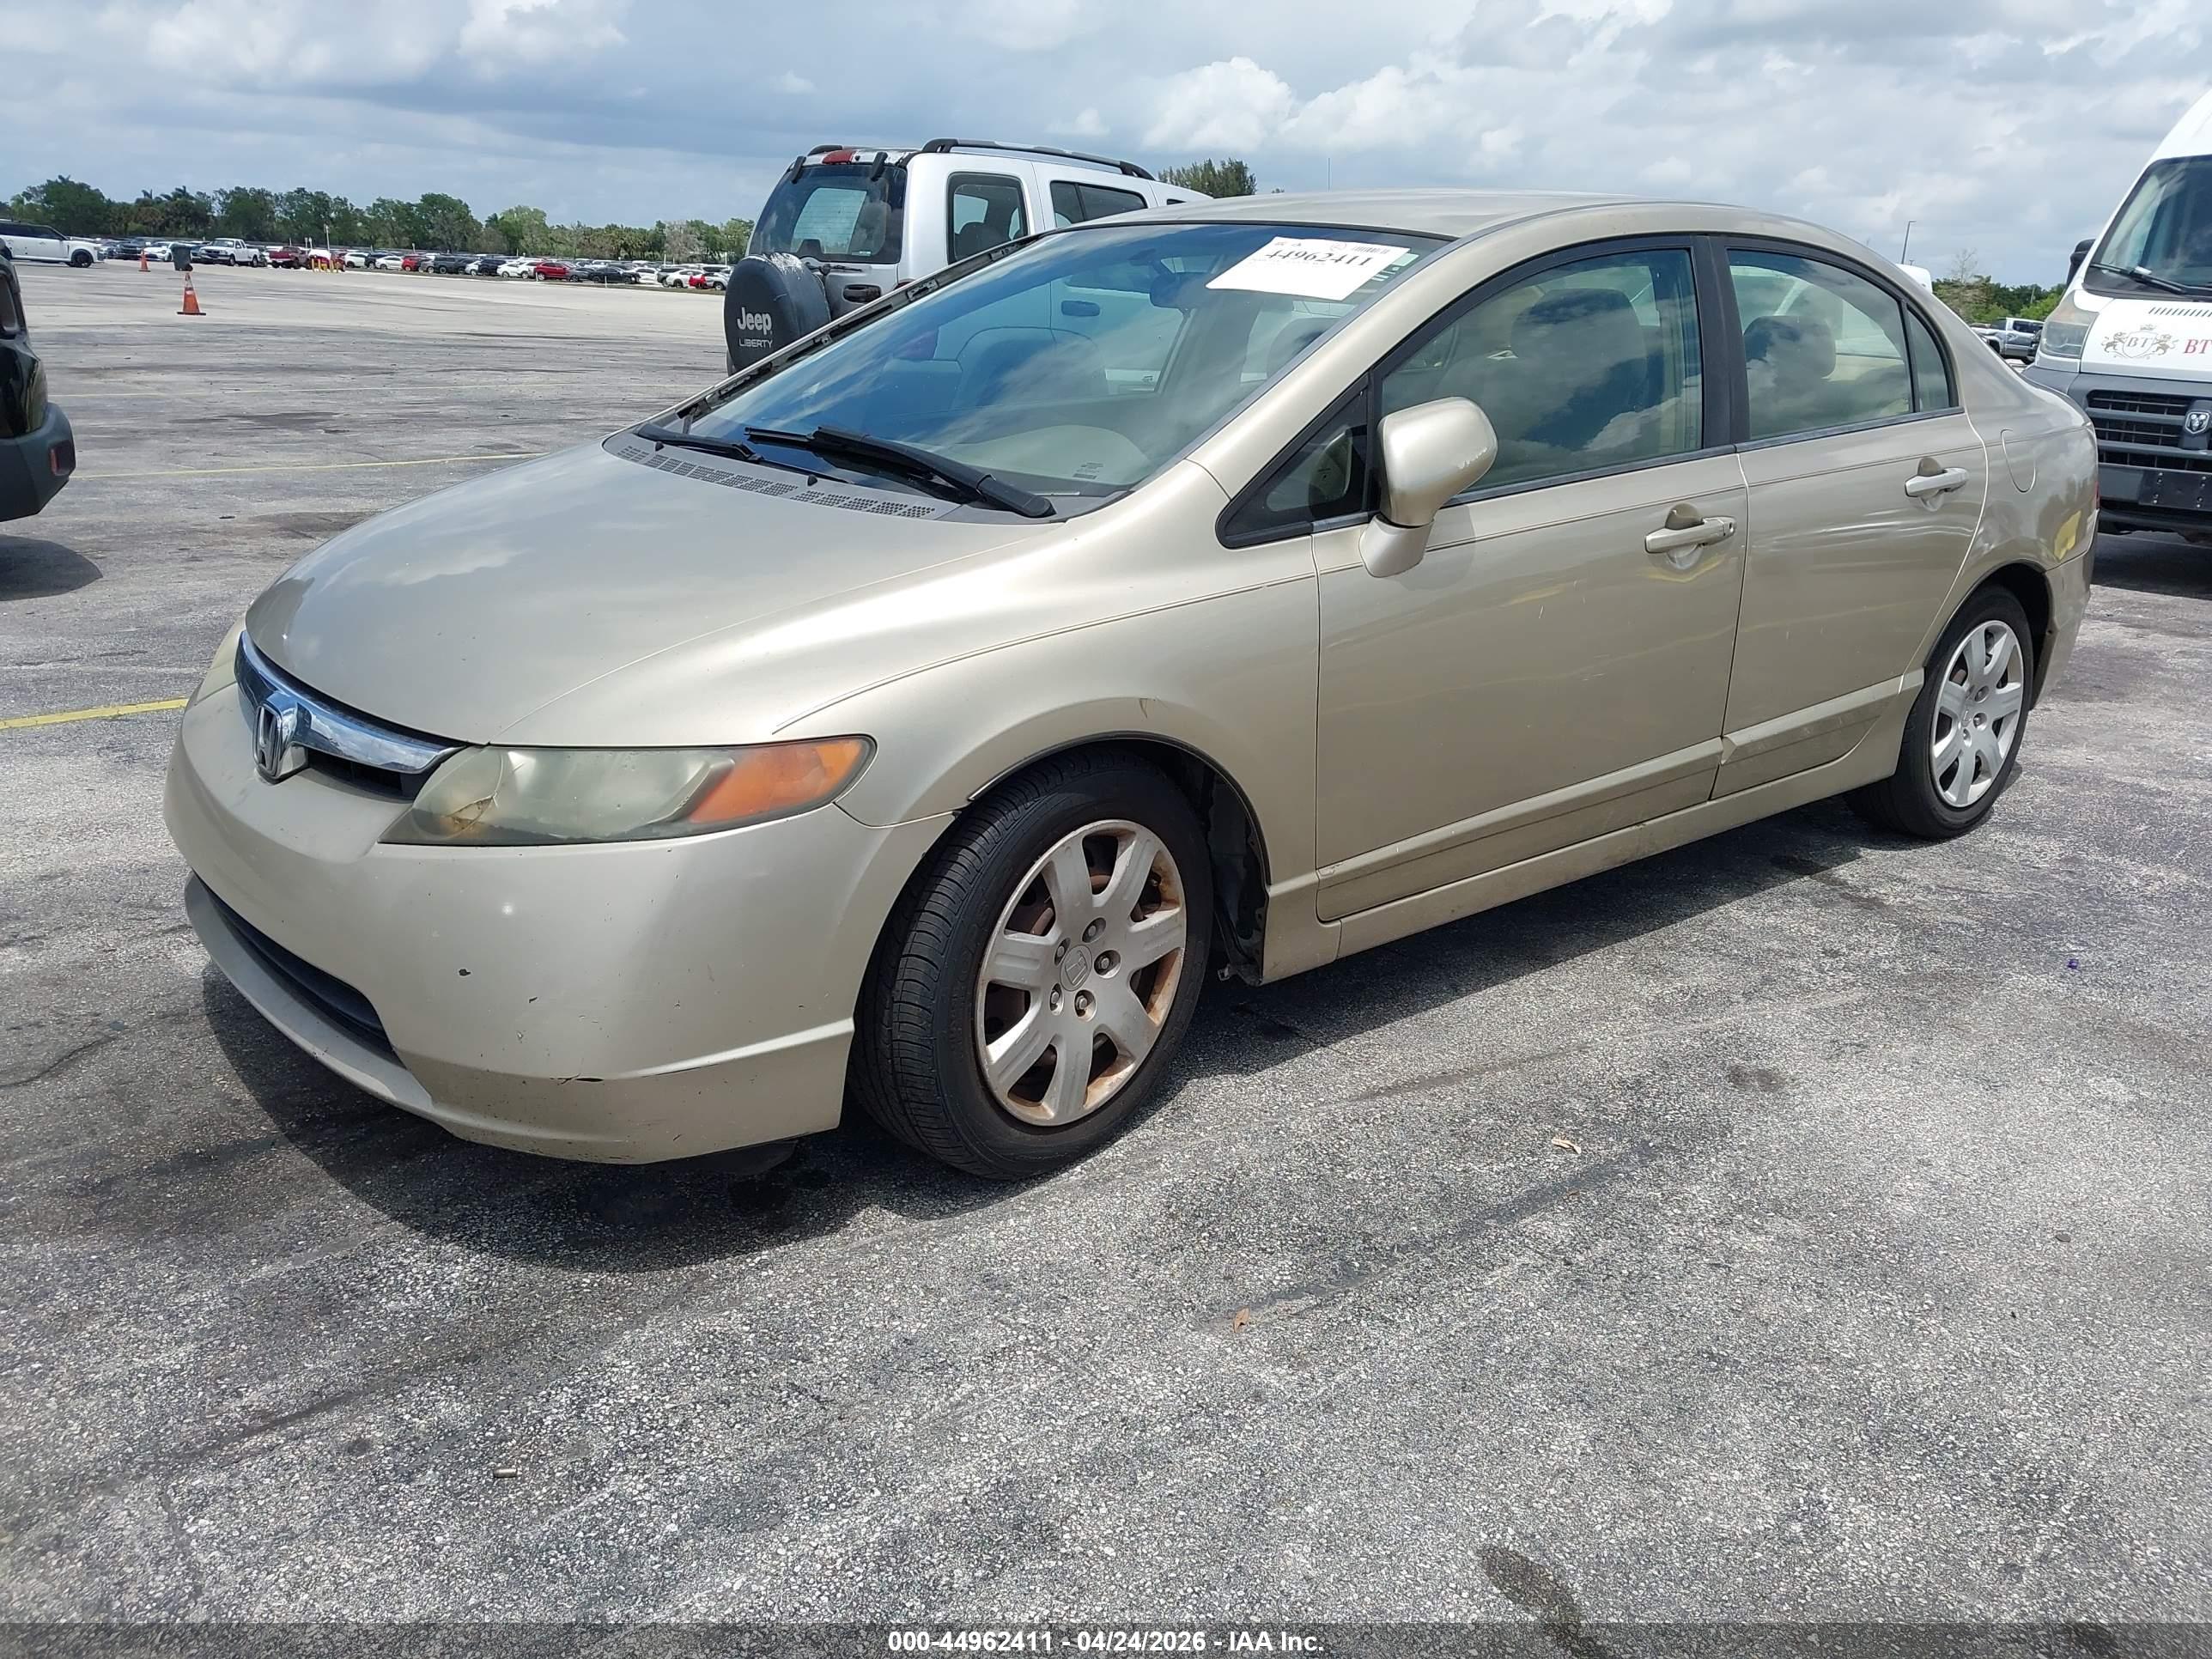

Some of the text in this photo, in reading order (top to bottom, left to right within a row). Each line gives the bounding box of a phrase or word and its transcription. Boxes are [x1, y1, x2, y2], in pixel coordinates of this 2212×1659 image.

[1266, 249, 1373, 266] 44962411
[737, 307, 773, 336] Jeep
[738, 337, 773, 349] LIBERTY
[2126, 337, 2155, 348] BT
